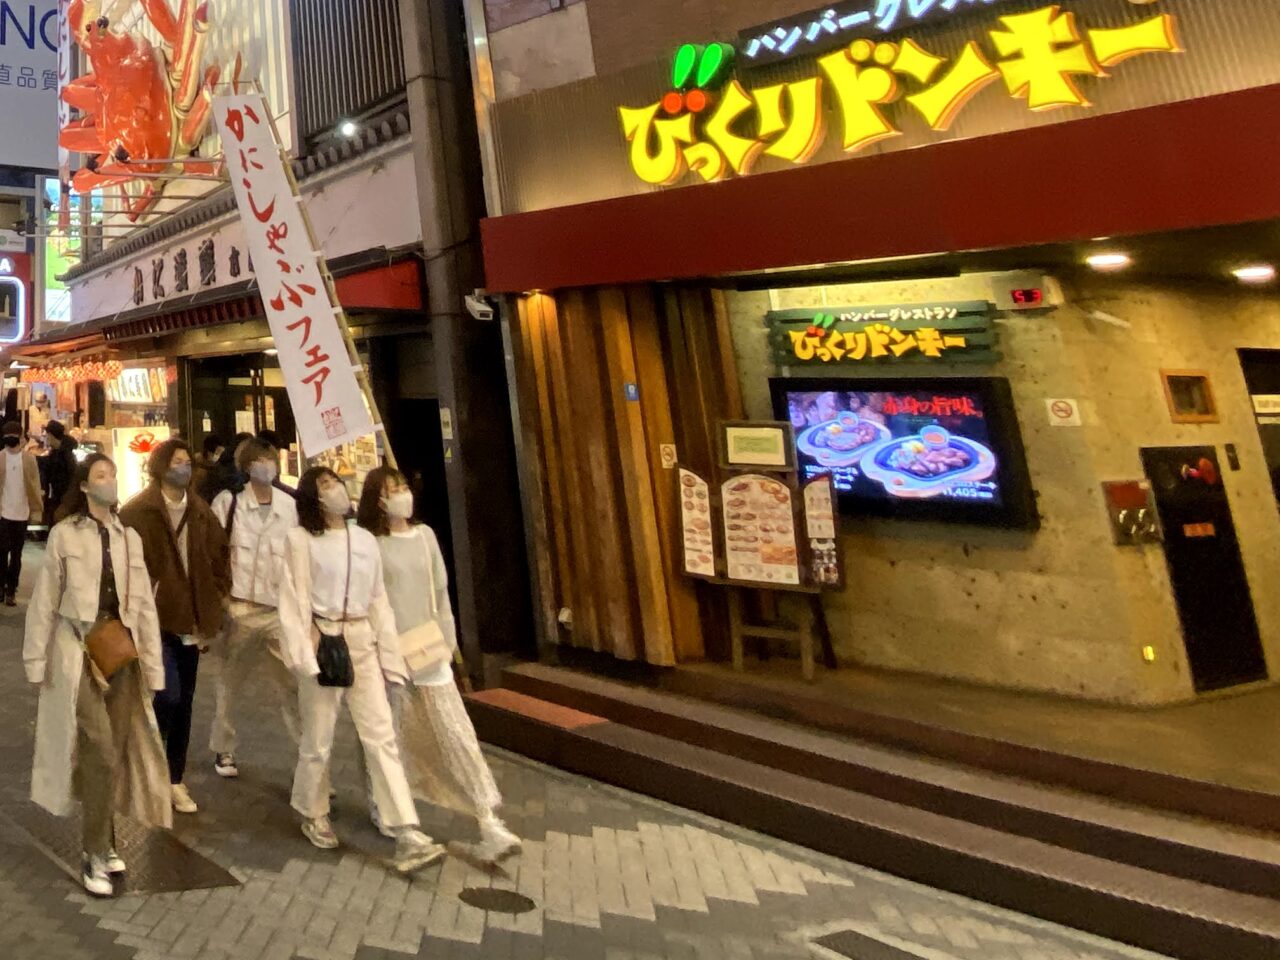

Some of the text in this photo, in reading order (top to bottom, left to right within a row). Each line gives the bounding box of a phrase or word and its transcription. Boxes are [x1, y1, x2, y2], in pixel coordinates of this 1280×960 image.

[619, 5, 1183, 184] びっくりドンキー
[225, 103, 331, 407] かにしゃぶフェア
[789, 323, 966, 362] びっくりドンキー
[839, 307, 958, 322] ハンバーグレストラン
